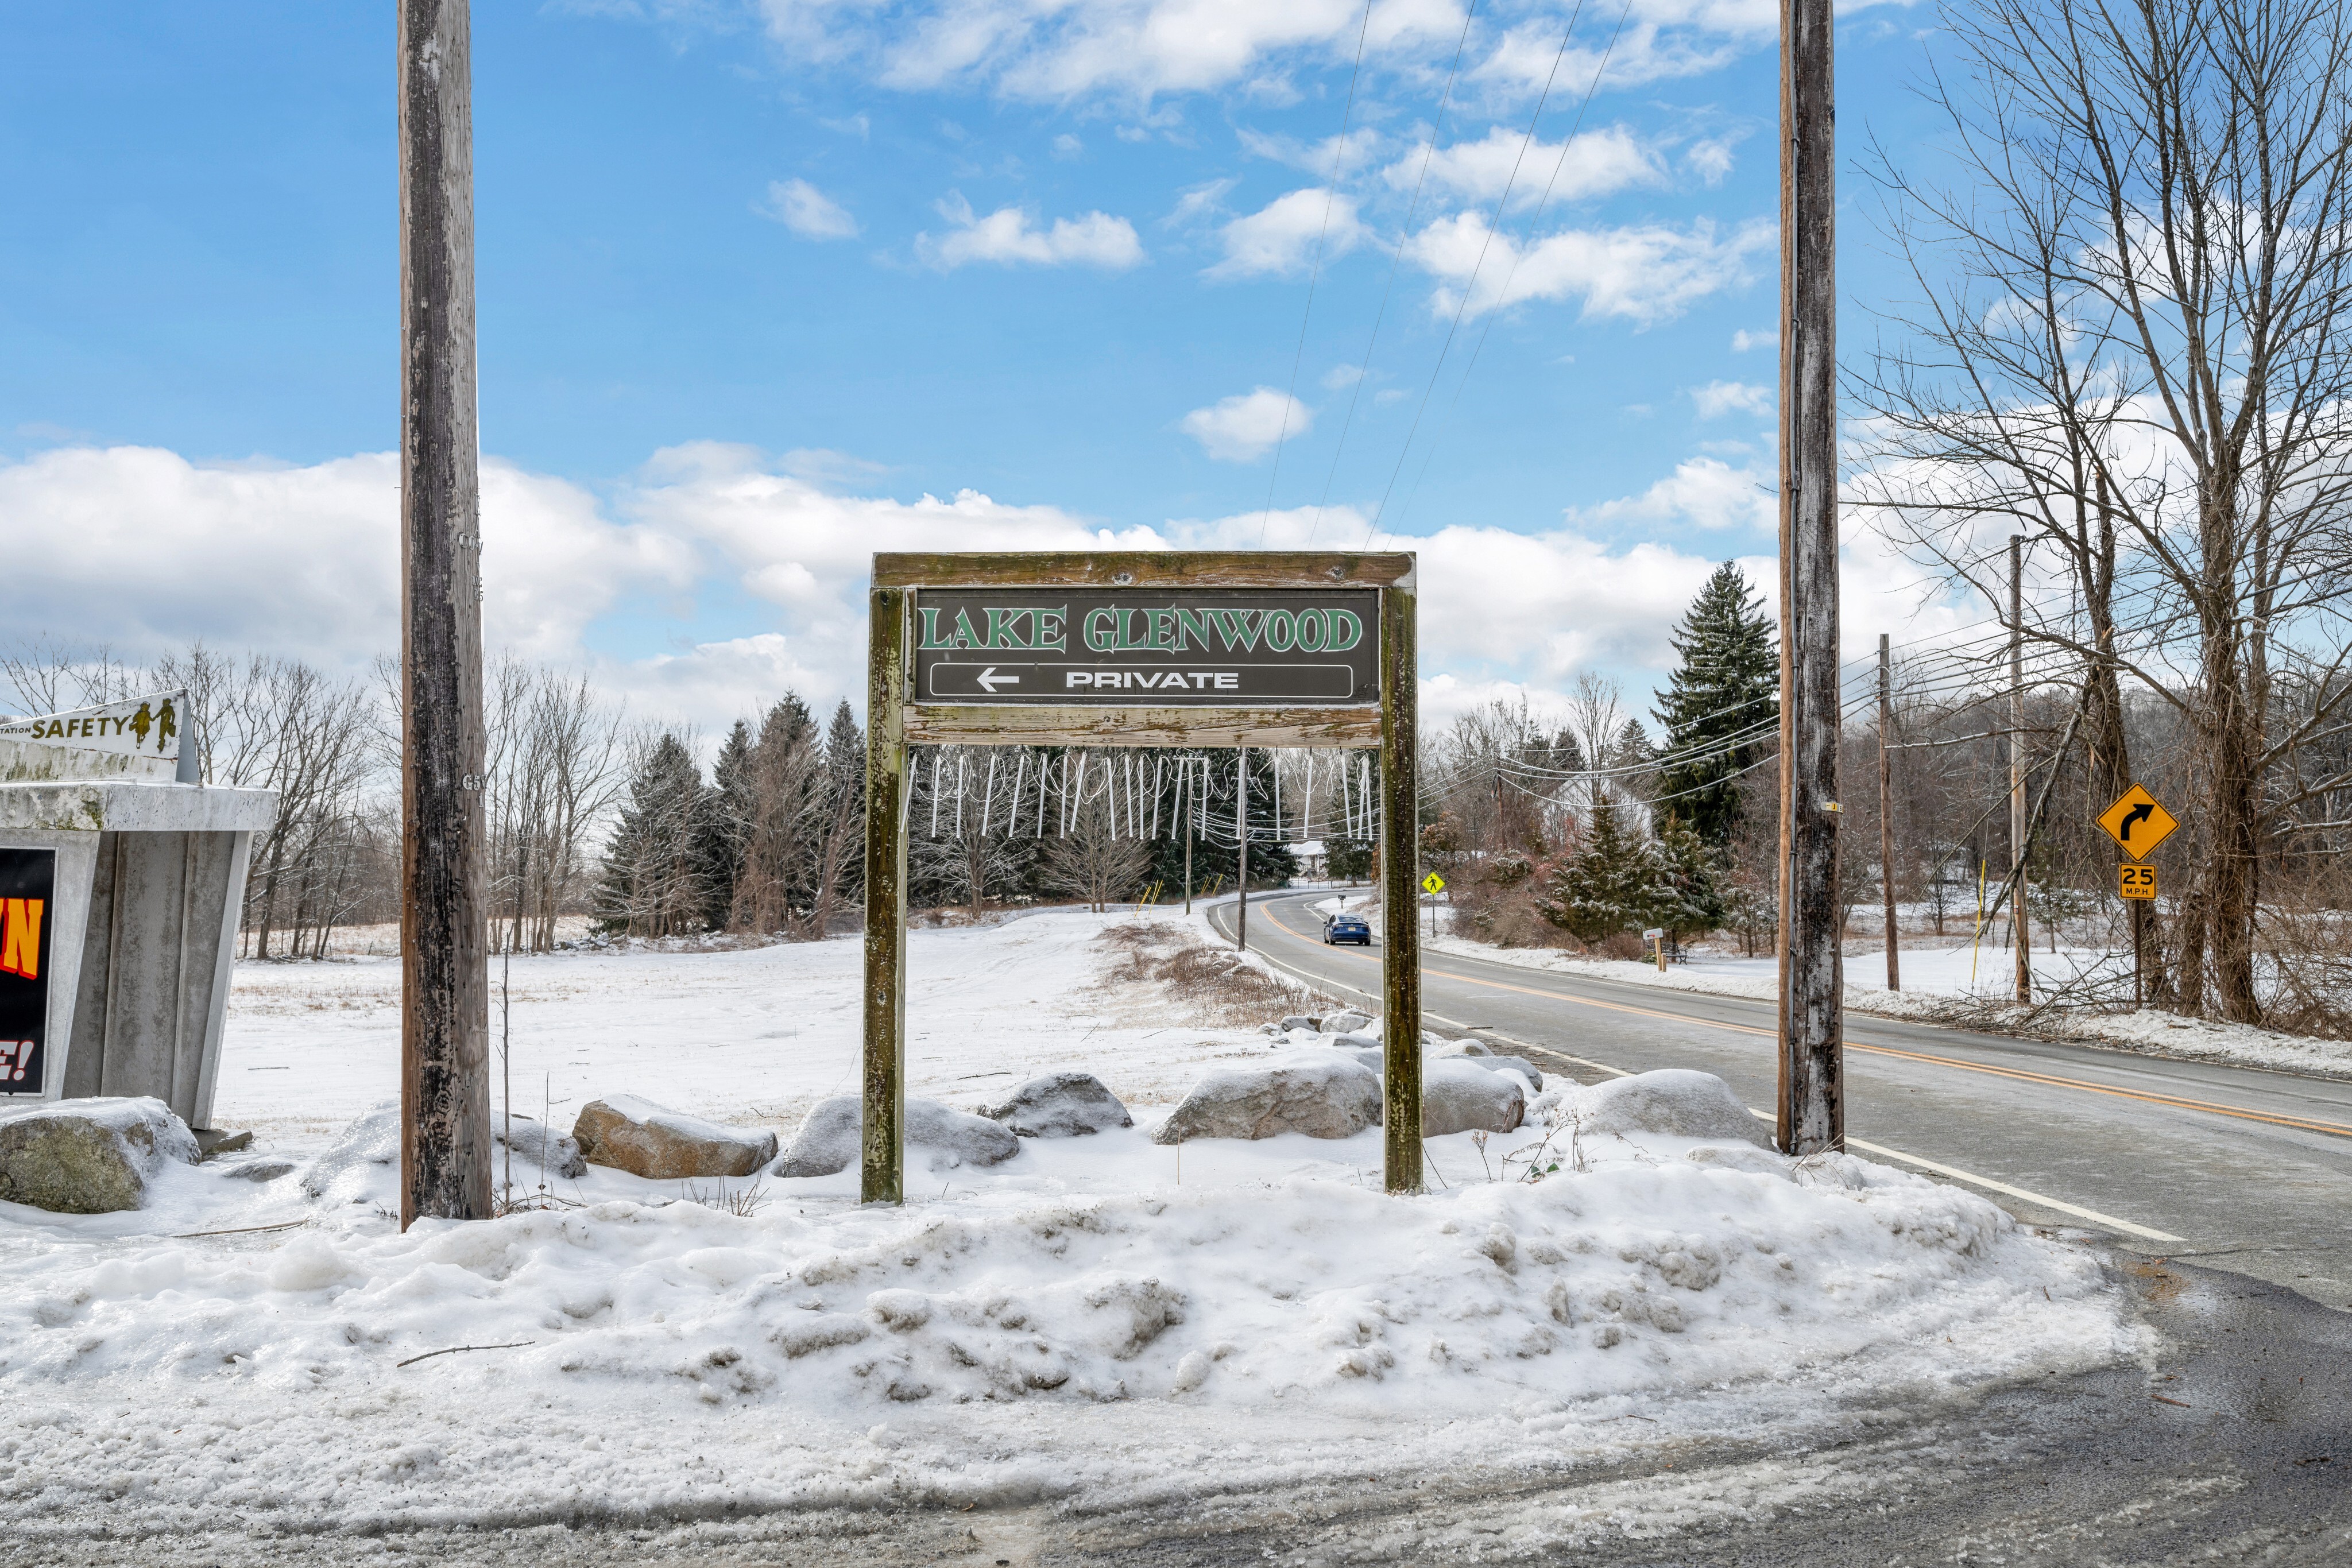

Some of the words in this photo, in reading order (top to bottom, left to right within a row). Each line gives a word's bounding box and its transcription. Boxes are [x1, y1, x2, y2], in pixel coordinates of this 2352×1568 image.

[917, 603, 1067, 654] LAKE
[1084, 603, 1363, 655] GLENWOOD
[1066, 672, 1239, 688] PRIVATE
[30, 716, 131, 739] SAFETY
[2123, 868, 2153, 885] 25
